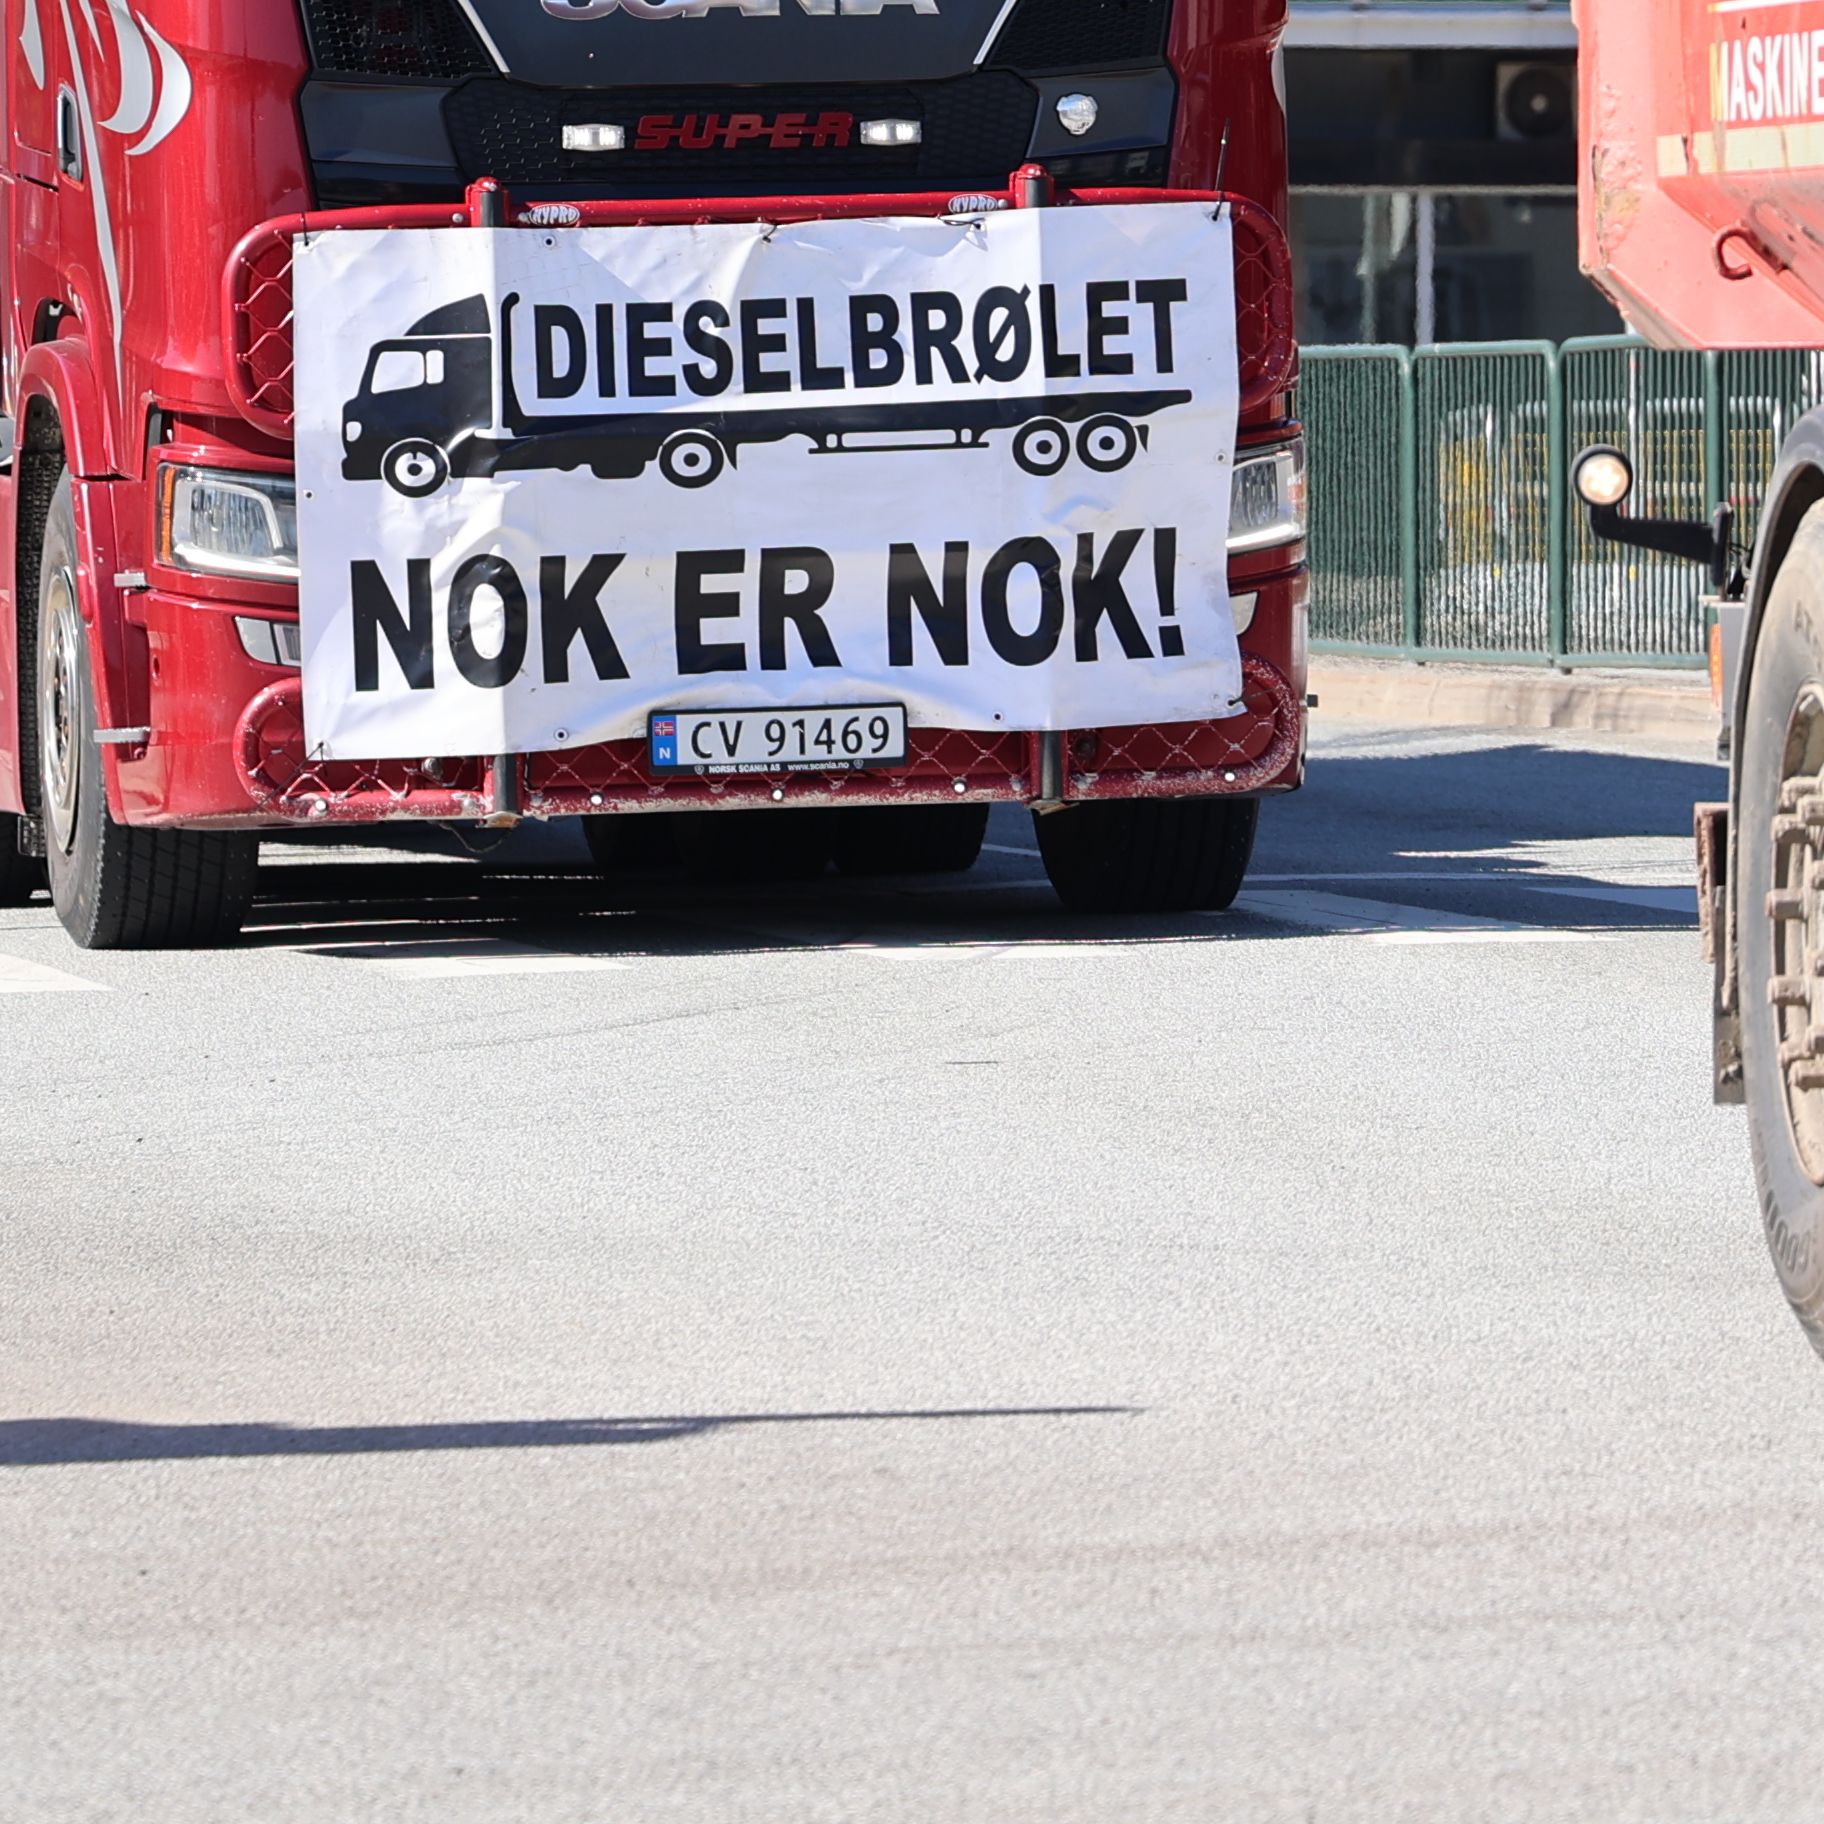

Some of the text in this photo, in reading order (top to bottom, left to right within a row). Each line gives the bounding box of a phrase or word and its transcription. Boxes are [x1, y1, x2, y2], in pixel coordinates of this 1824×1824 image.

[634, 111, 855, 150] SUPER
[533, 278, 1188, 400] DIESELBRØLET
[349, 526, 1186, 692] NOK ER NOK!
[658, 746, 671, 759] N
[691, 715, 890, 759] CV 91469
[708, 760, 850, 774] NORSK SCANIA AS www.scania.no
